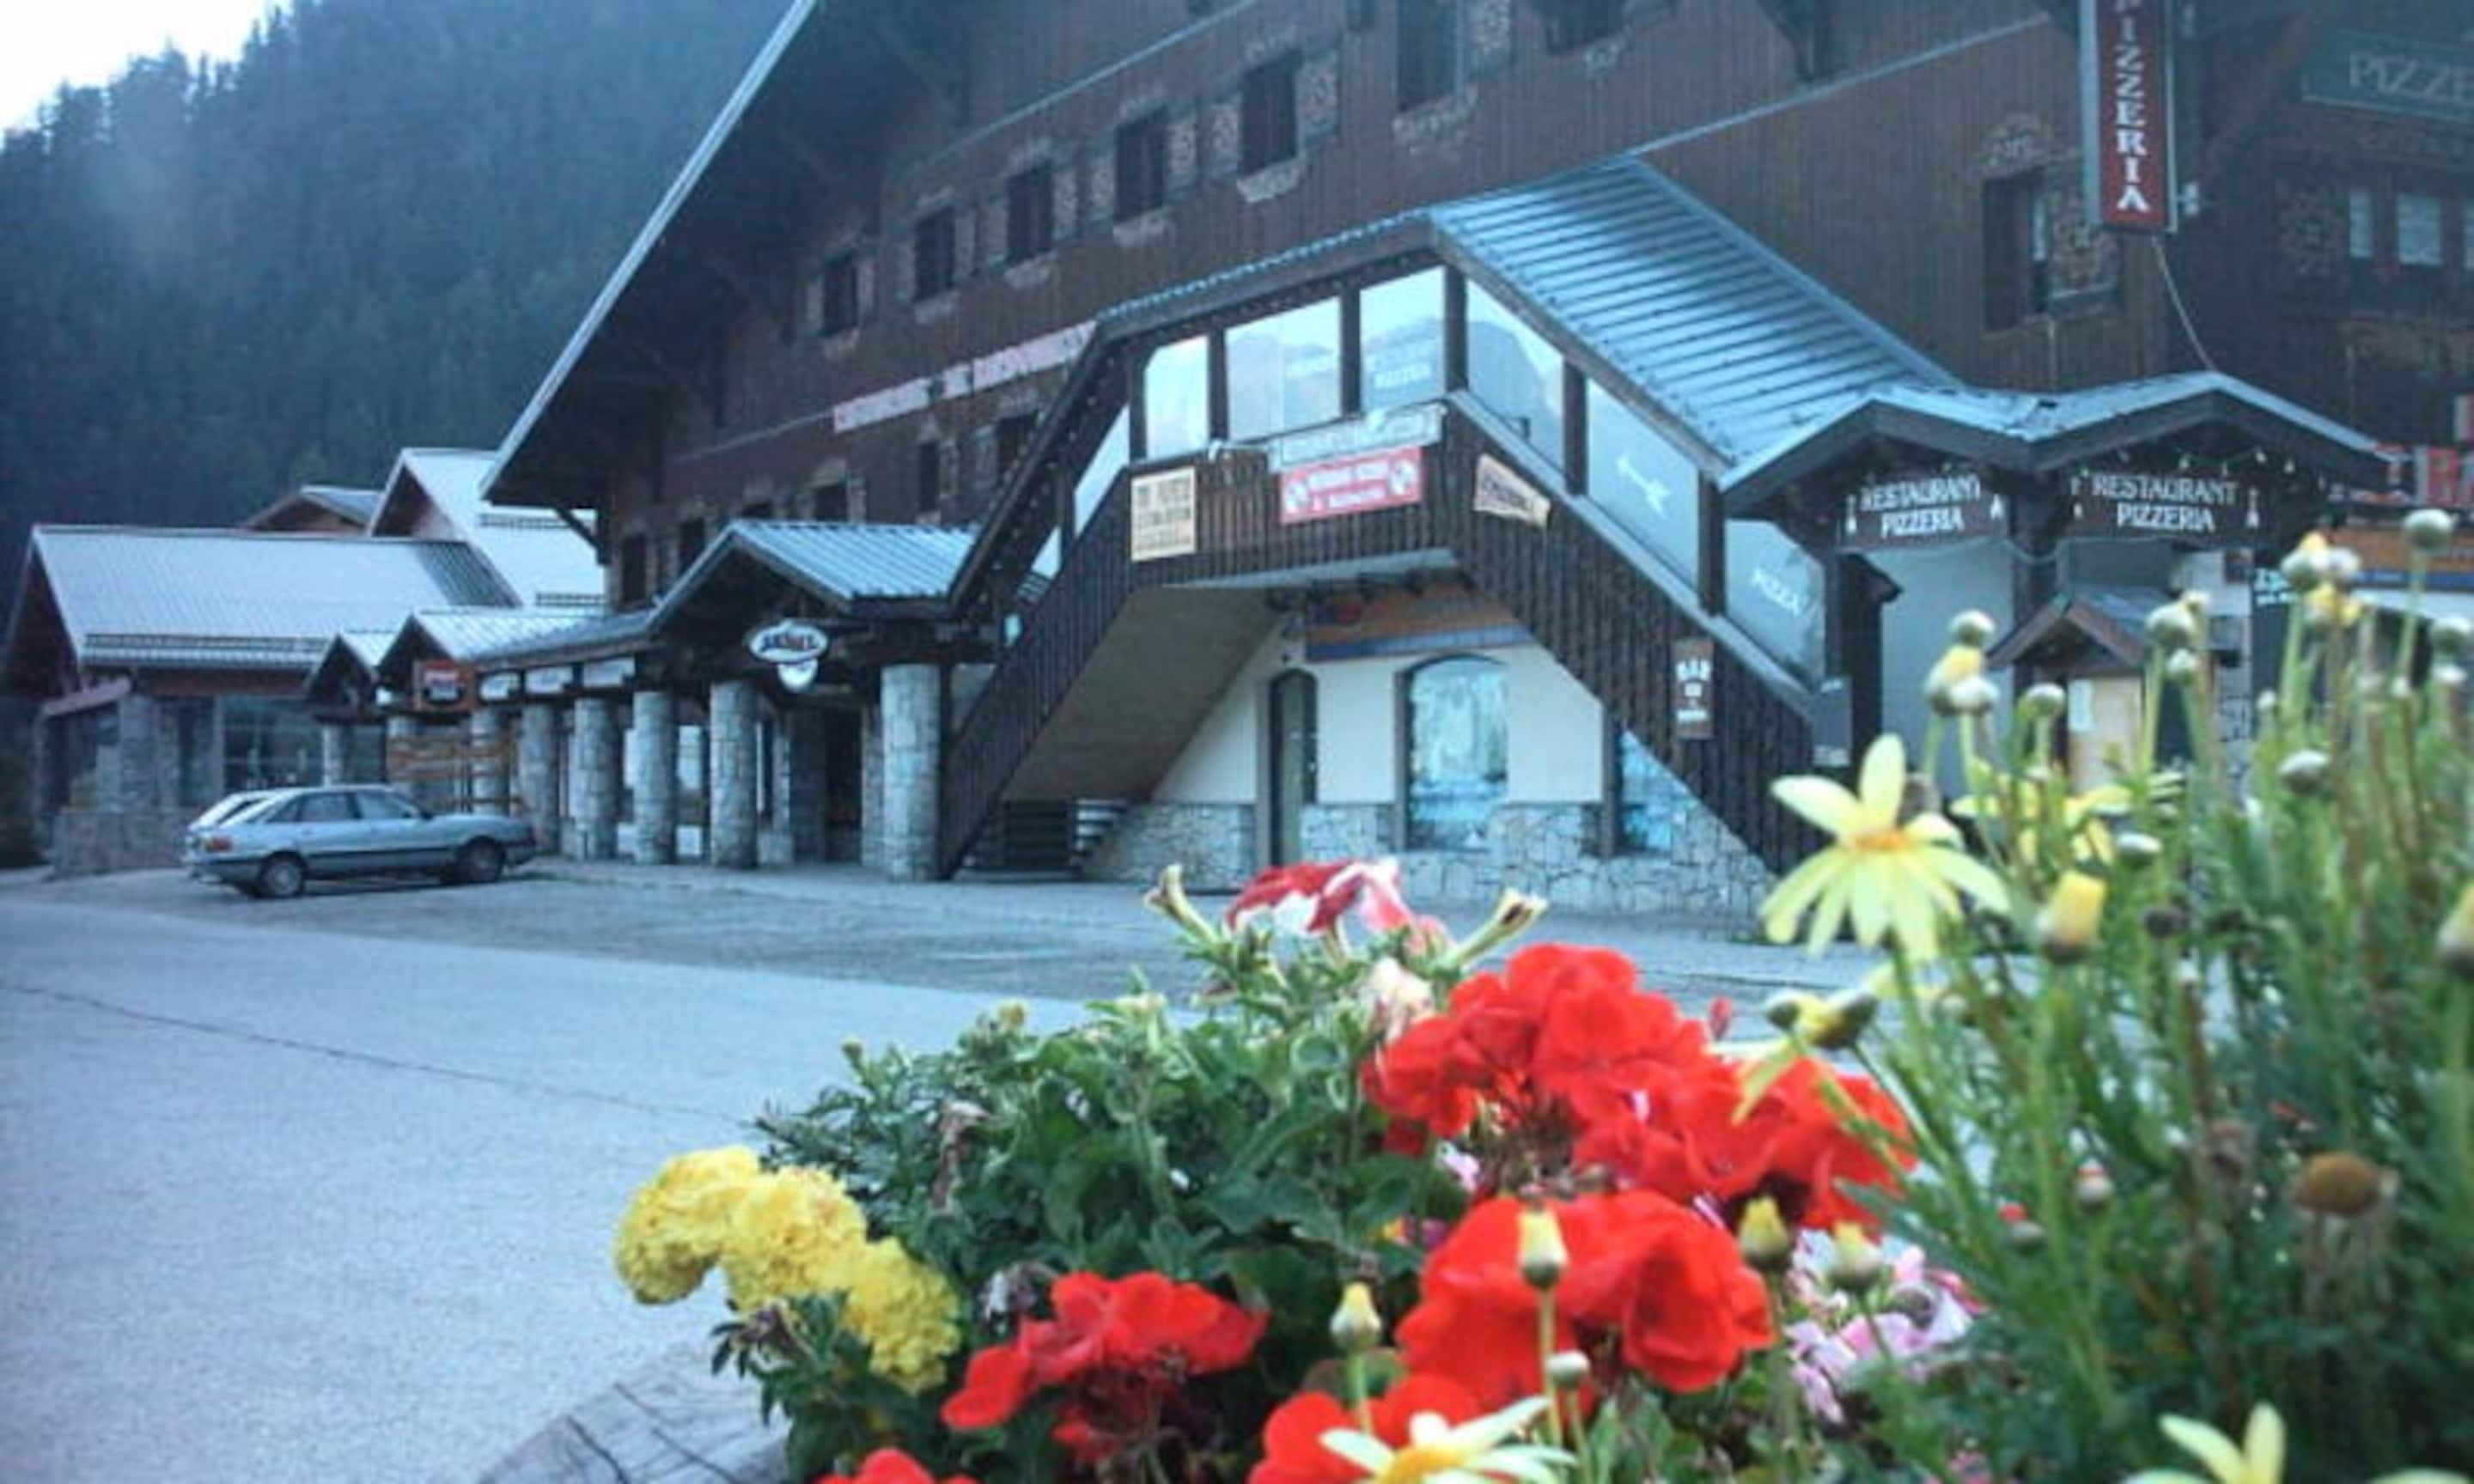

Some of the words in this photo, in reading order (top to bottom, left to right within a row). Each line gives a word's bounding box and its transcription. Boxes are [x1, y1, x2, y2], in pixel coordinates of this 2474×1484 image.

[1860, 473, 1981, 511] RESTAURANT
[2092, 474, 2239, 505] RESTAURANT
[1881, 507, 1965, 538] PIZZERIA
[2117, 502, 2216, 532] PIZZERIA
